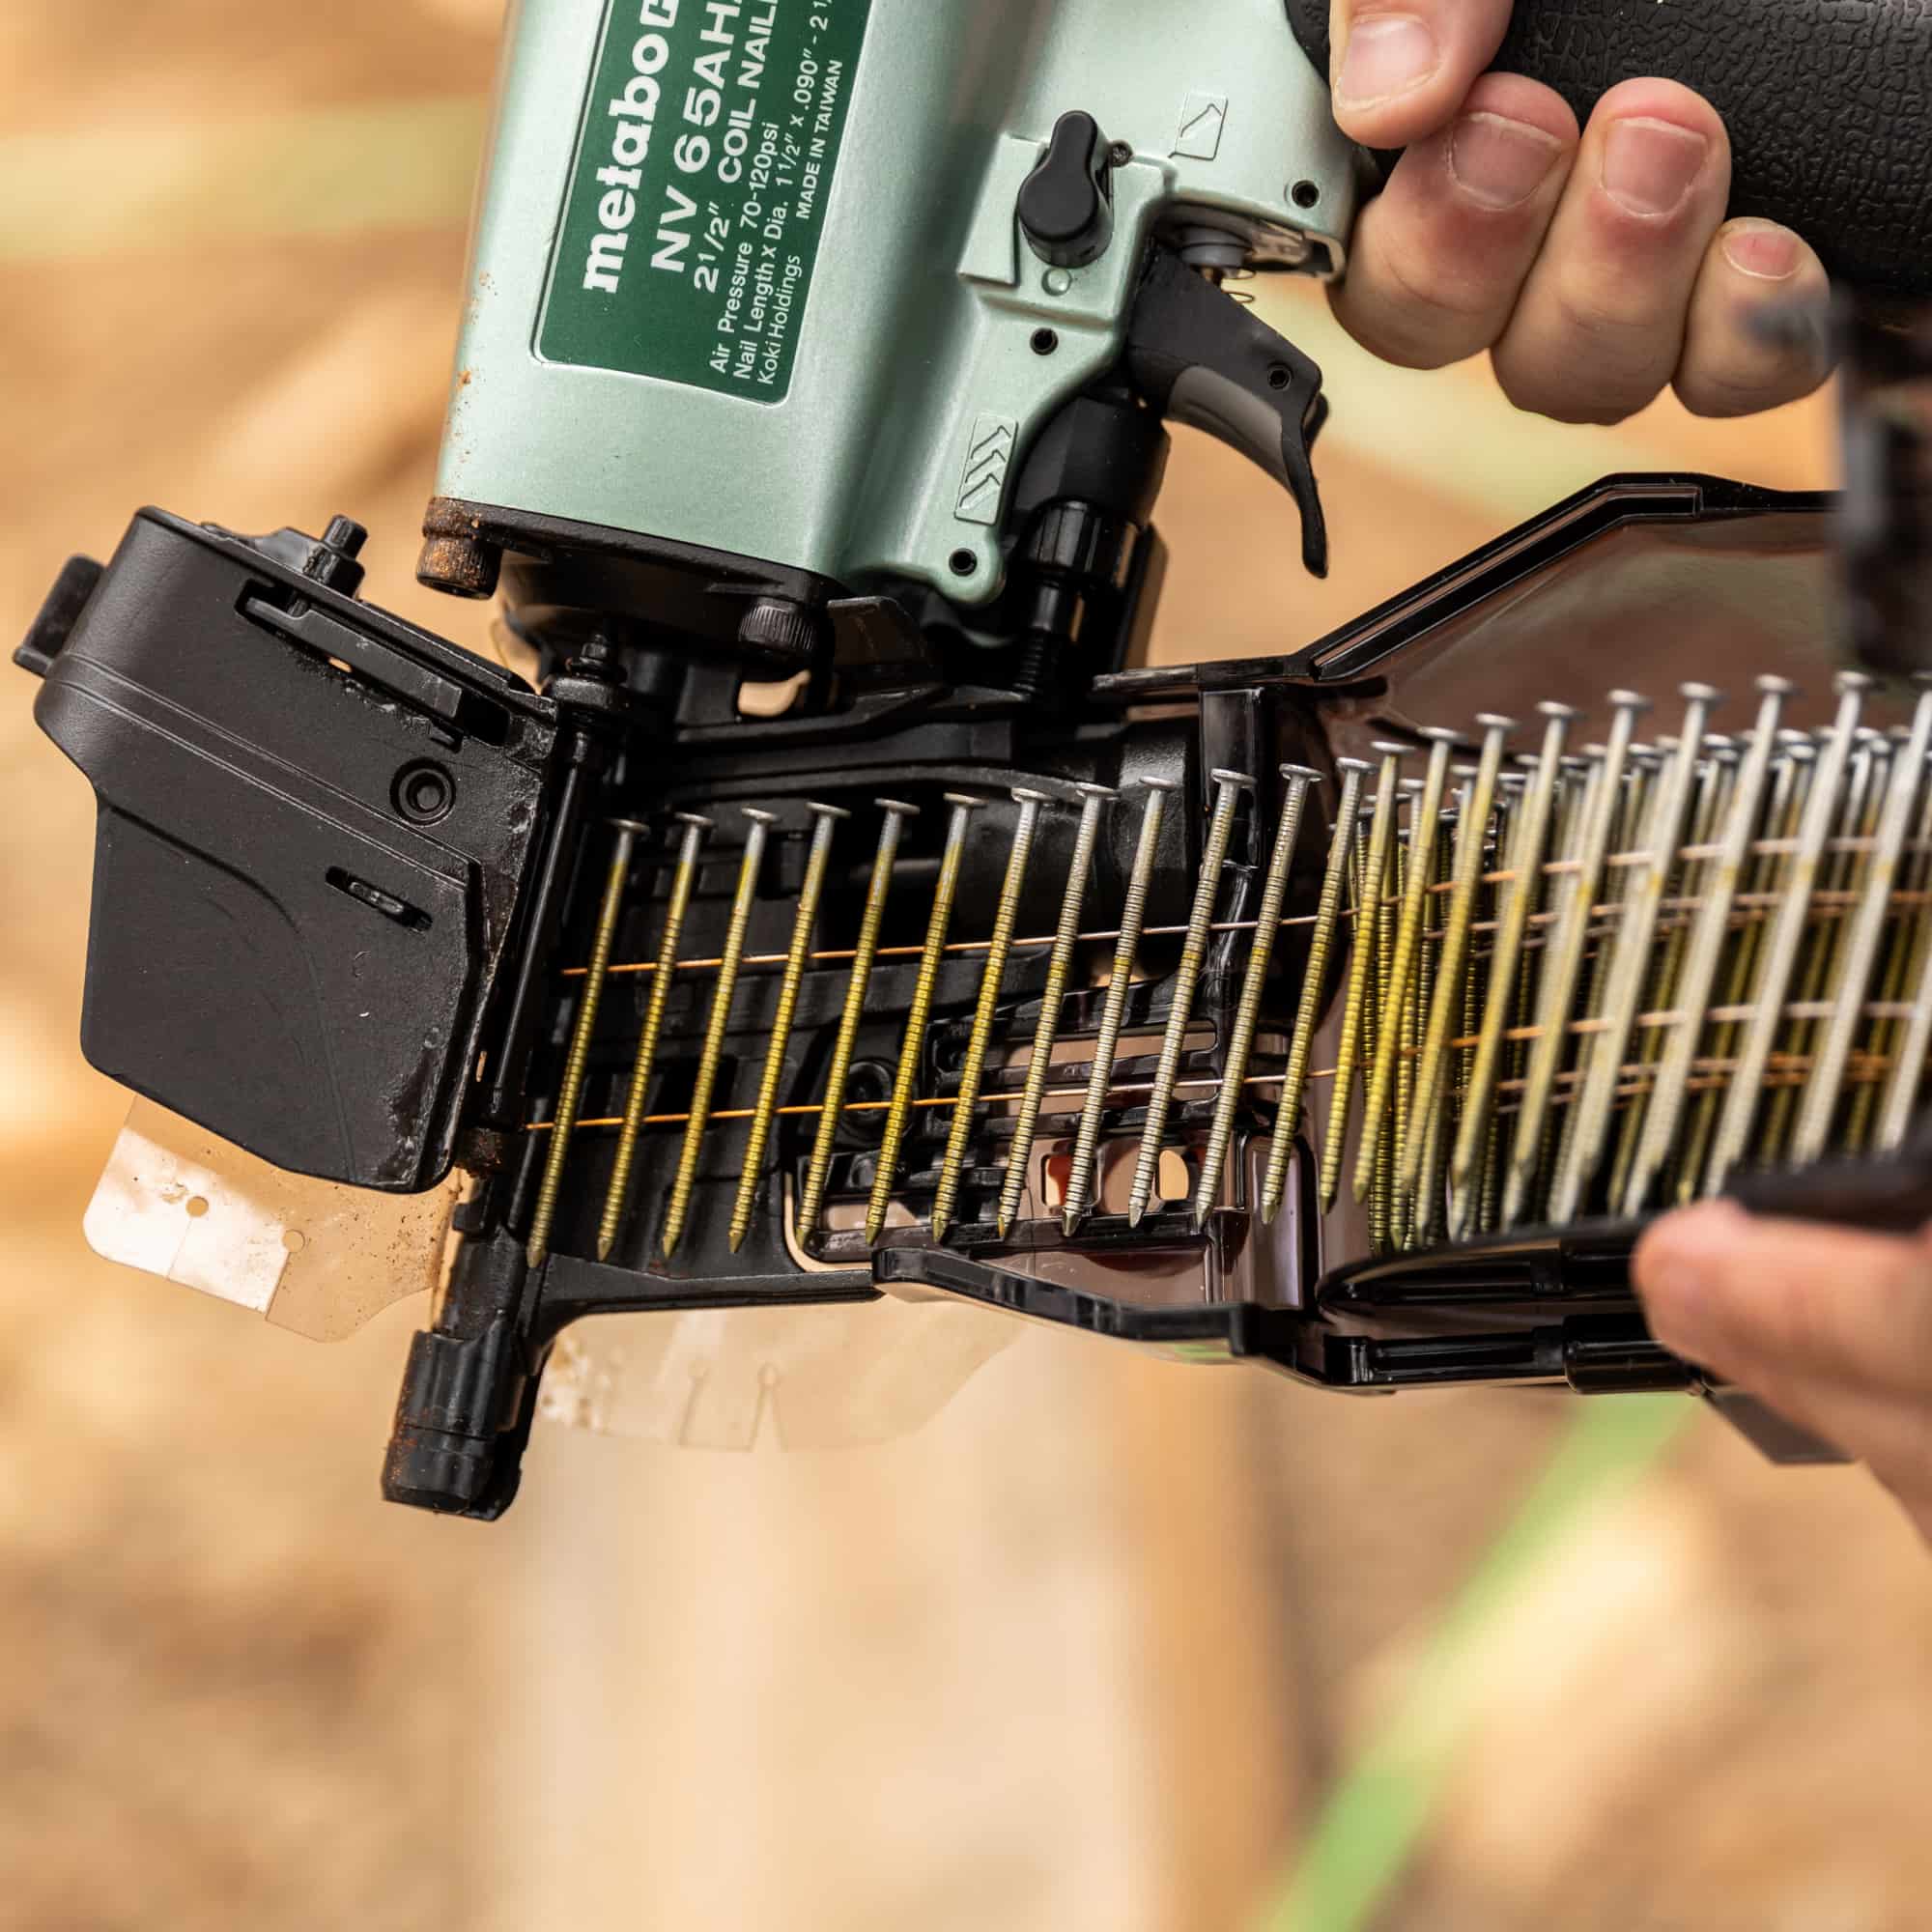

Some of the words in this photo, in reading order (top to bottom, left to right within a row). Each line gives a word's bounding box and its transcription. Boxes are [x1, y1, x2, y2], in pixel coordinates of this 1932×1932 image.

[672, 0, 743, 174] 65AH
[717, 98, 756, 184] COIL
[737, 0, 779, 89] NAIL
[789, 114, 805, 128] x
[813, 59, 843, 133] TAIWAN
[582, 33, 669, 295] metabo
[739, 123, 780, 229] 70-120psi
[809, 137, 826, 158] IN
[763, 200, 789, 241] Dia.
[795, 161, 821, 219] MADE
[650, 185, 697, 273] NV
[760, 243, 777, 259] x
[717, 242, 753, 333] Pressure
[743, 262, 776, 332] Length
[767, 255, 803, 339] Holdings
[709, 344, 731, 374] Air
[732, 339, 758, 380] Nail
[756, 342, 781, 384] Koki
